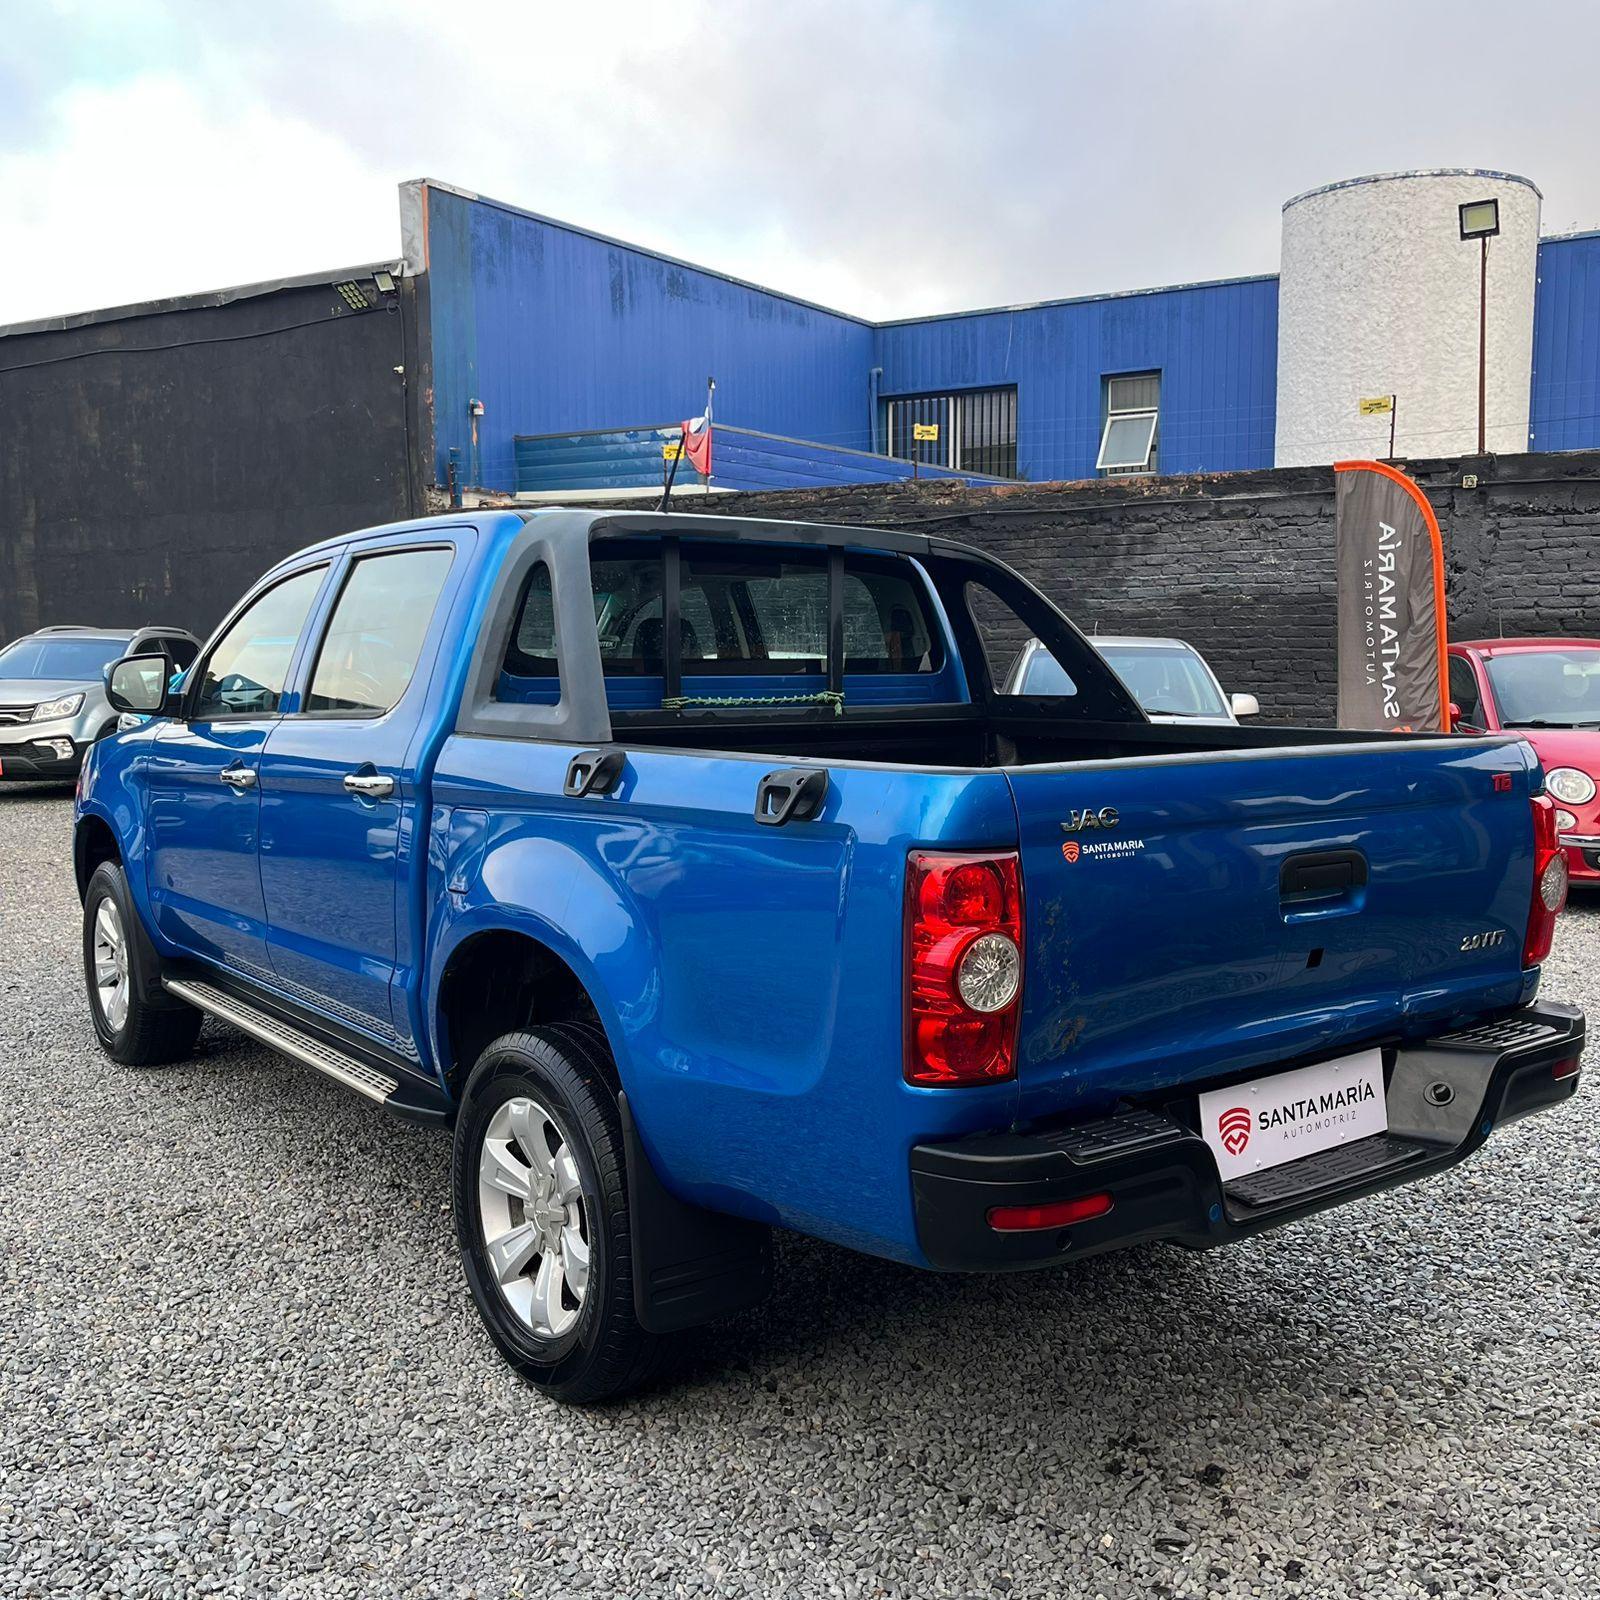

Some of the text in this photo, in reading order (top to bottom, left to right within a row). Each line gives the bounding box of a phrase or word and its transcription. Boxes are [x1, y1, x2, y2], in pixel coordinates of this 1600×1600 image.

[1491, 772, 1512, 792] T6
[1060, 806, 1120, 832] JAC
[1258, 1078, 1376, 1131] SANTAMARÍA
[1283, 1110, 1358, 1140] AUTOMOTRIZ
